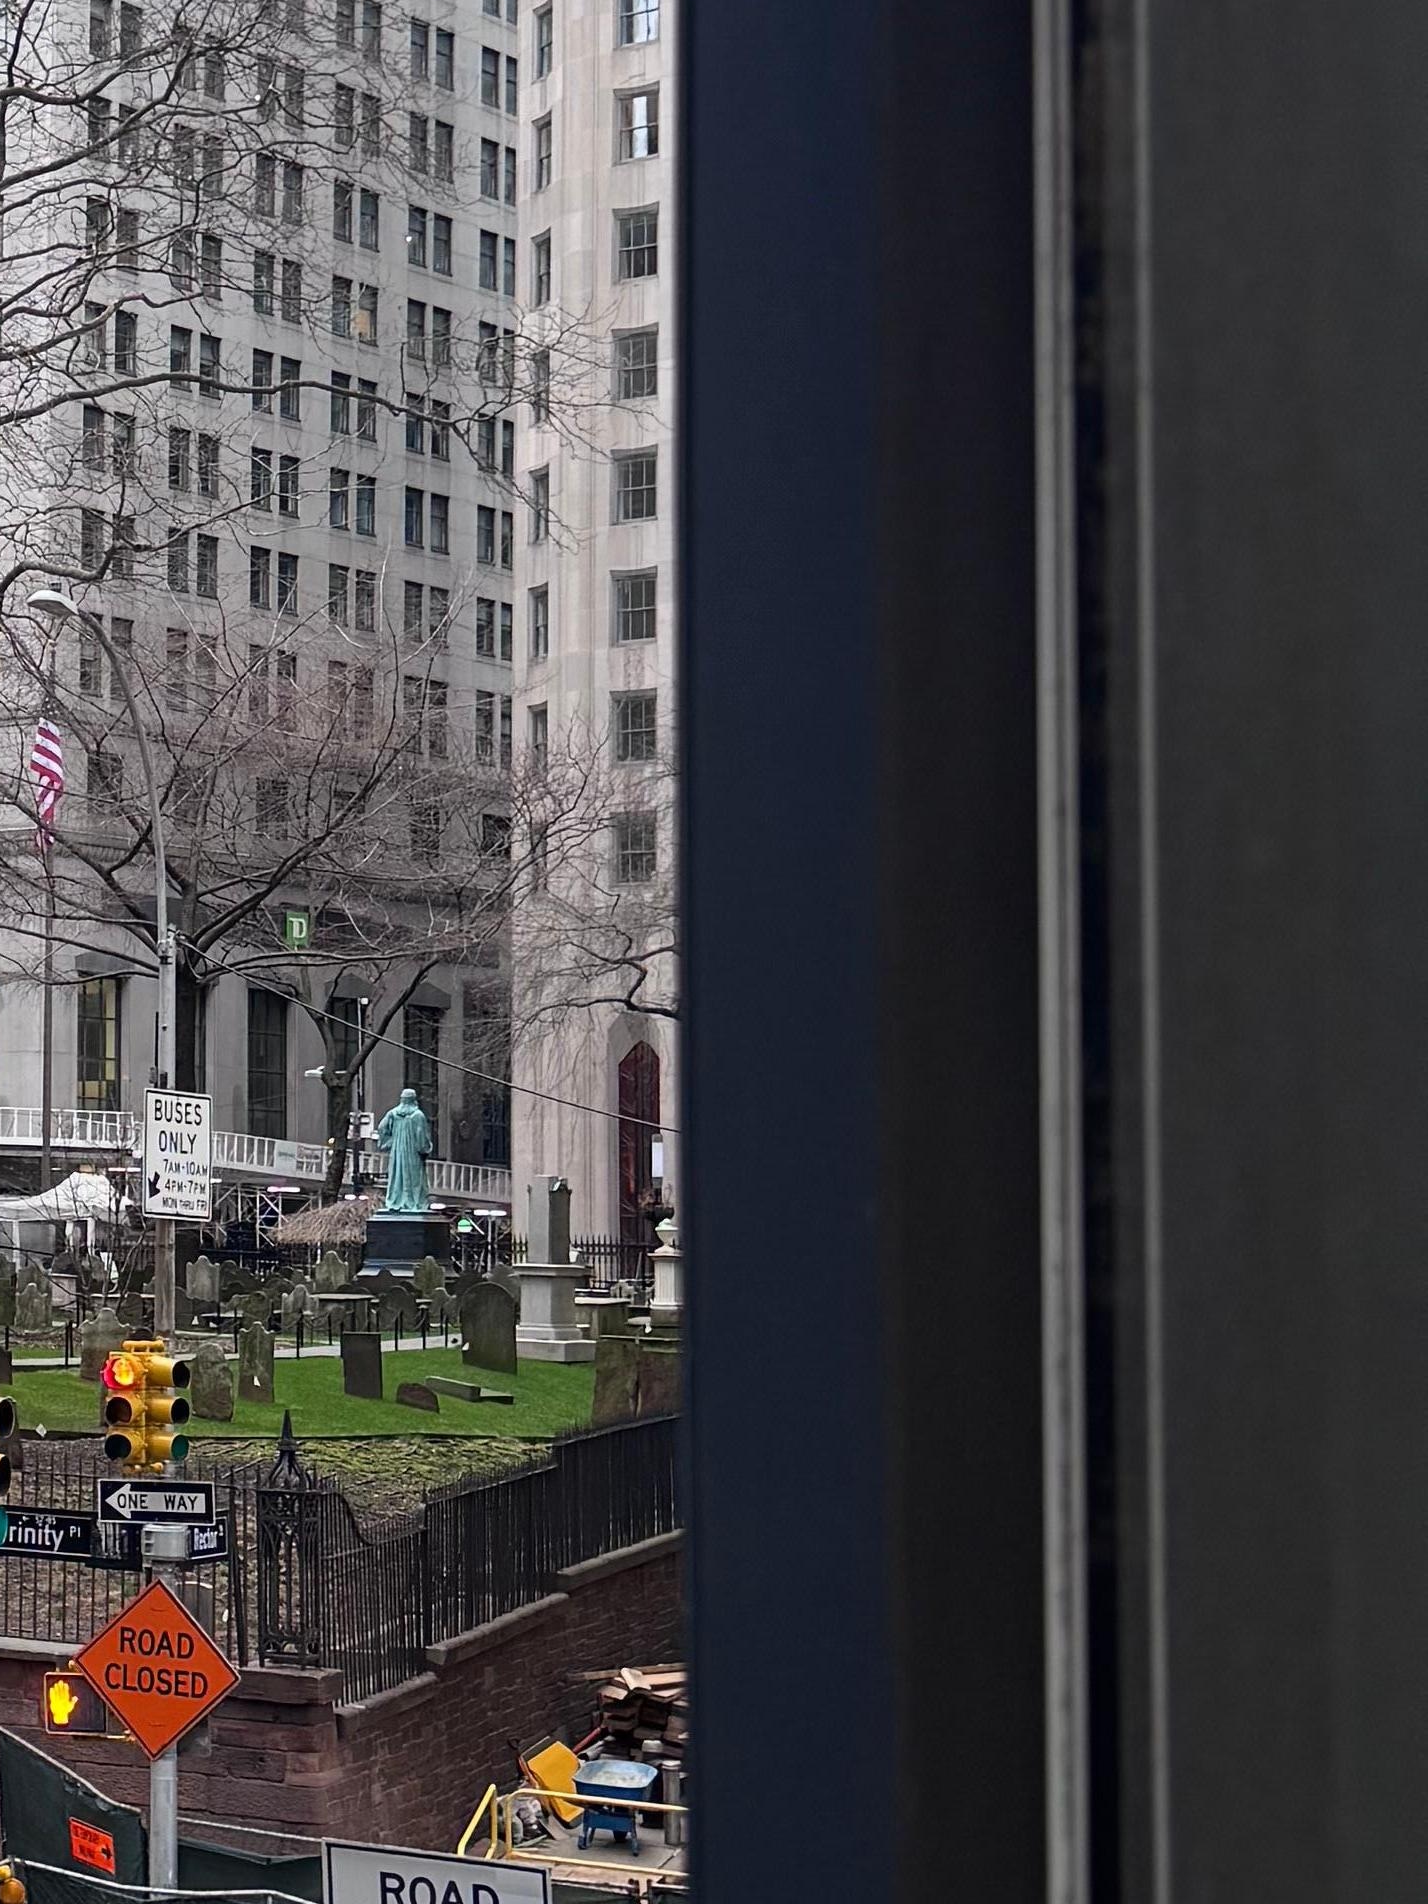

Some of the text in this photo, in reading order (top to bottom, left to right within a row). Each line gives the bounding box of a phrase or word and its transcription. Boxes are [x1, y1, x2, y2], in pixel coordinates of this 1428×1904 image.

[154, 1099, 202, 1126] BUSES
[158, 1130, 197, 1154] ONLY
[117, 1493, 199, 1511] ONE WAY
[8, 1520, 64, 1552] rinity
[69, 1525, 81, 1538] Pl
[119, 1626, 195, 1660] ROAD
[104, 1663, 209, 1699] CLOSED
